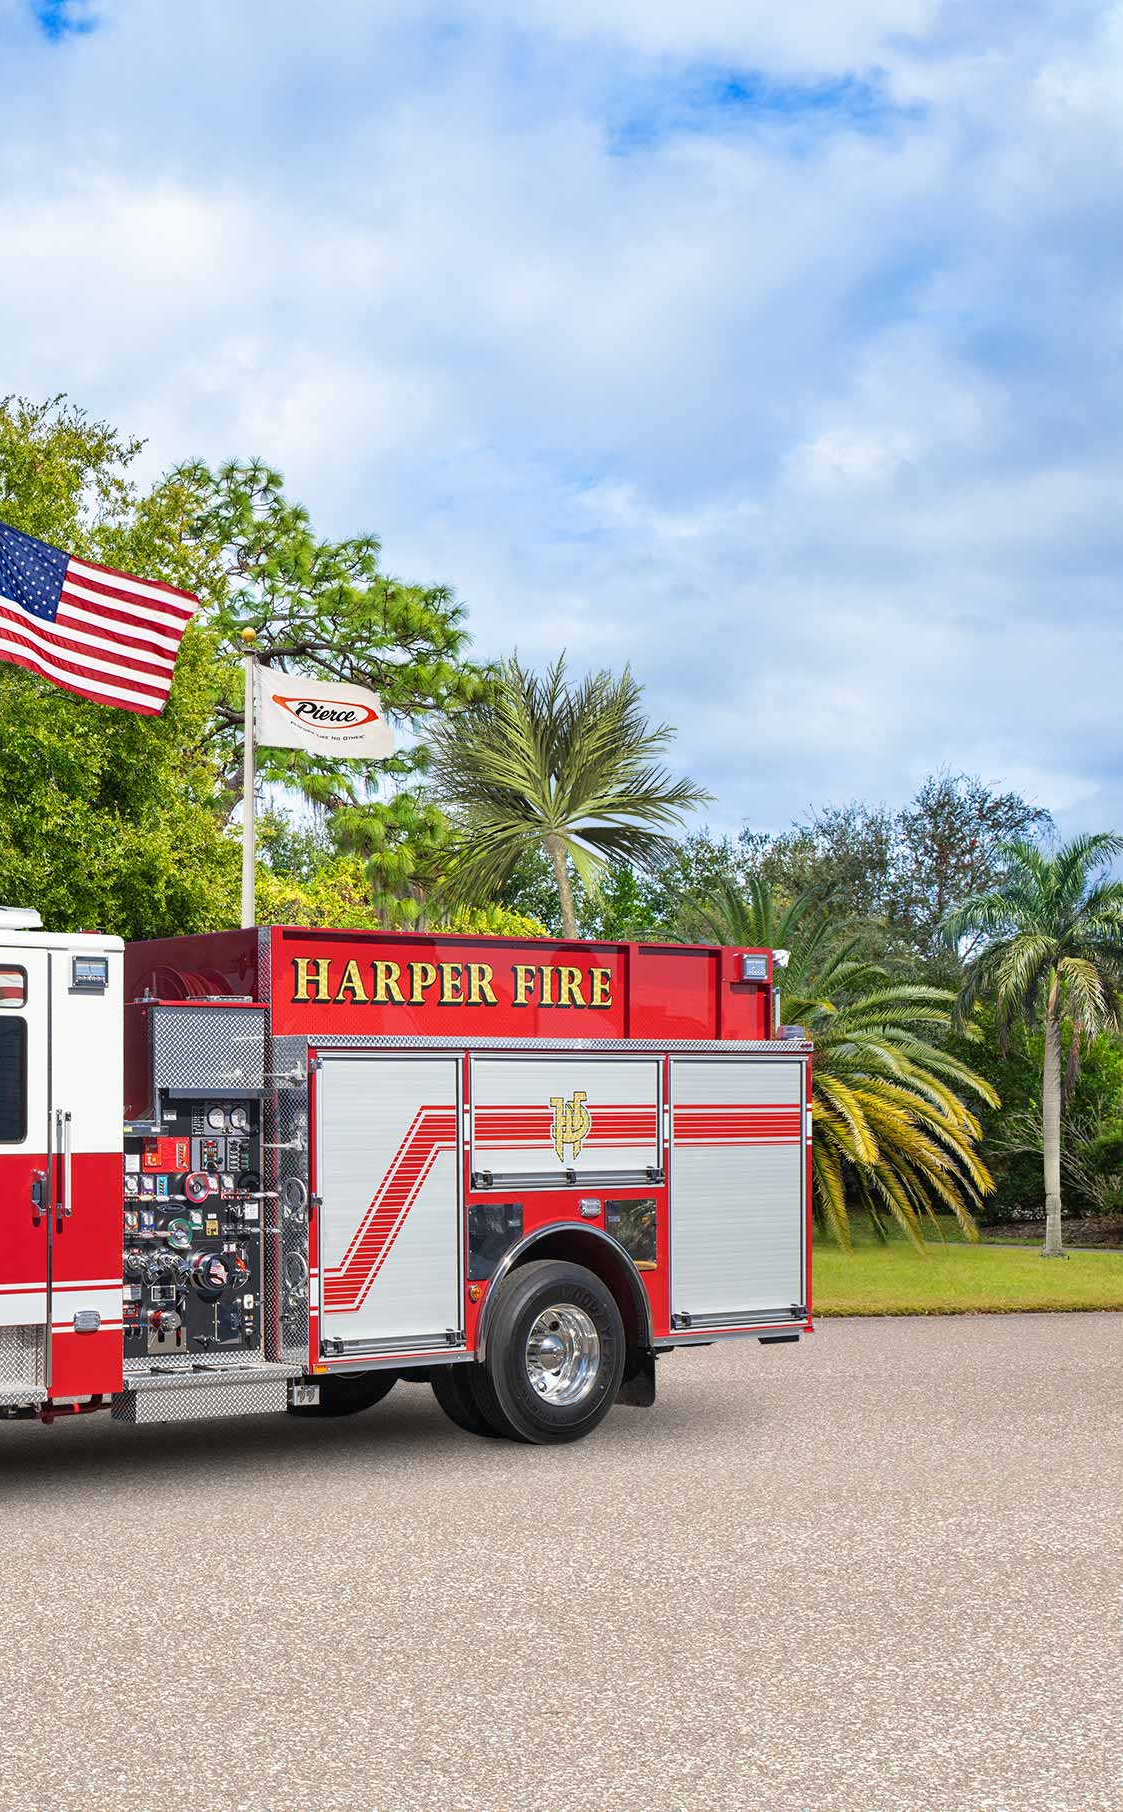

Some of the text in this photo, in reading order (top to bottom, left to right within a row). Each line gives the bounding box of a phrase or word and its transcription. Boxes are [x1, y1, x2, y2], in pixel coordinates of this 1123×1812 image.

[295, 701, 356, 722] Pierce
[291, 957, 613, 1010] HARPER FIRE
